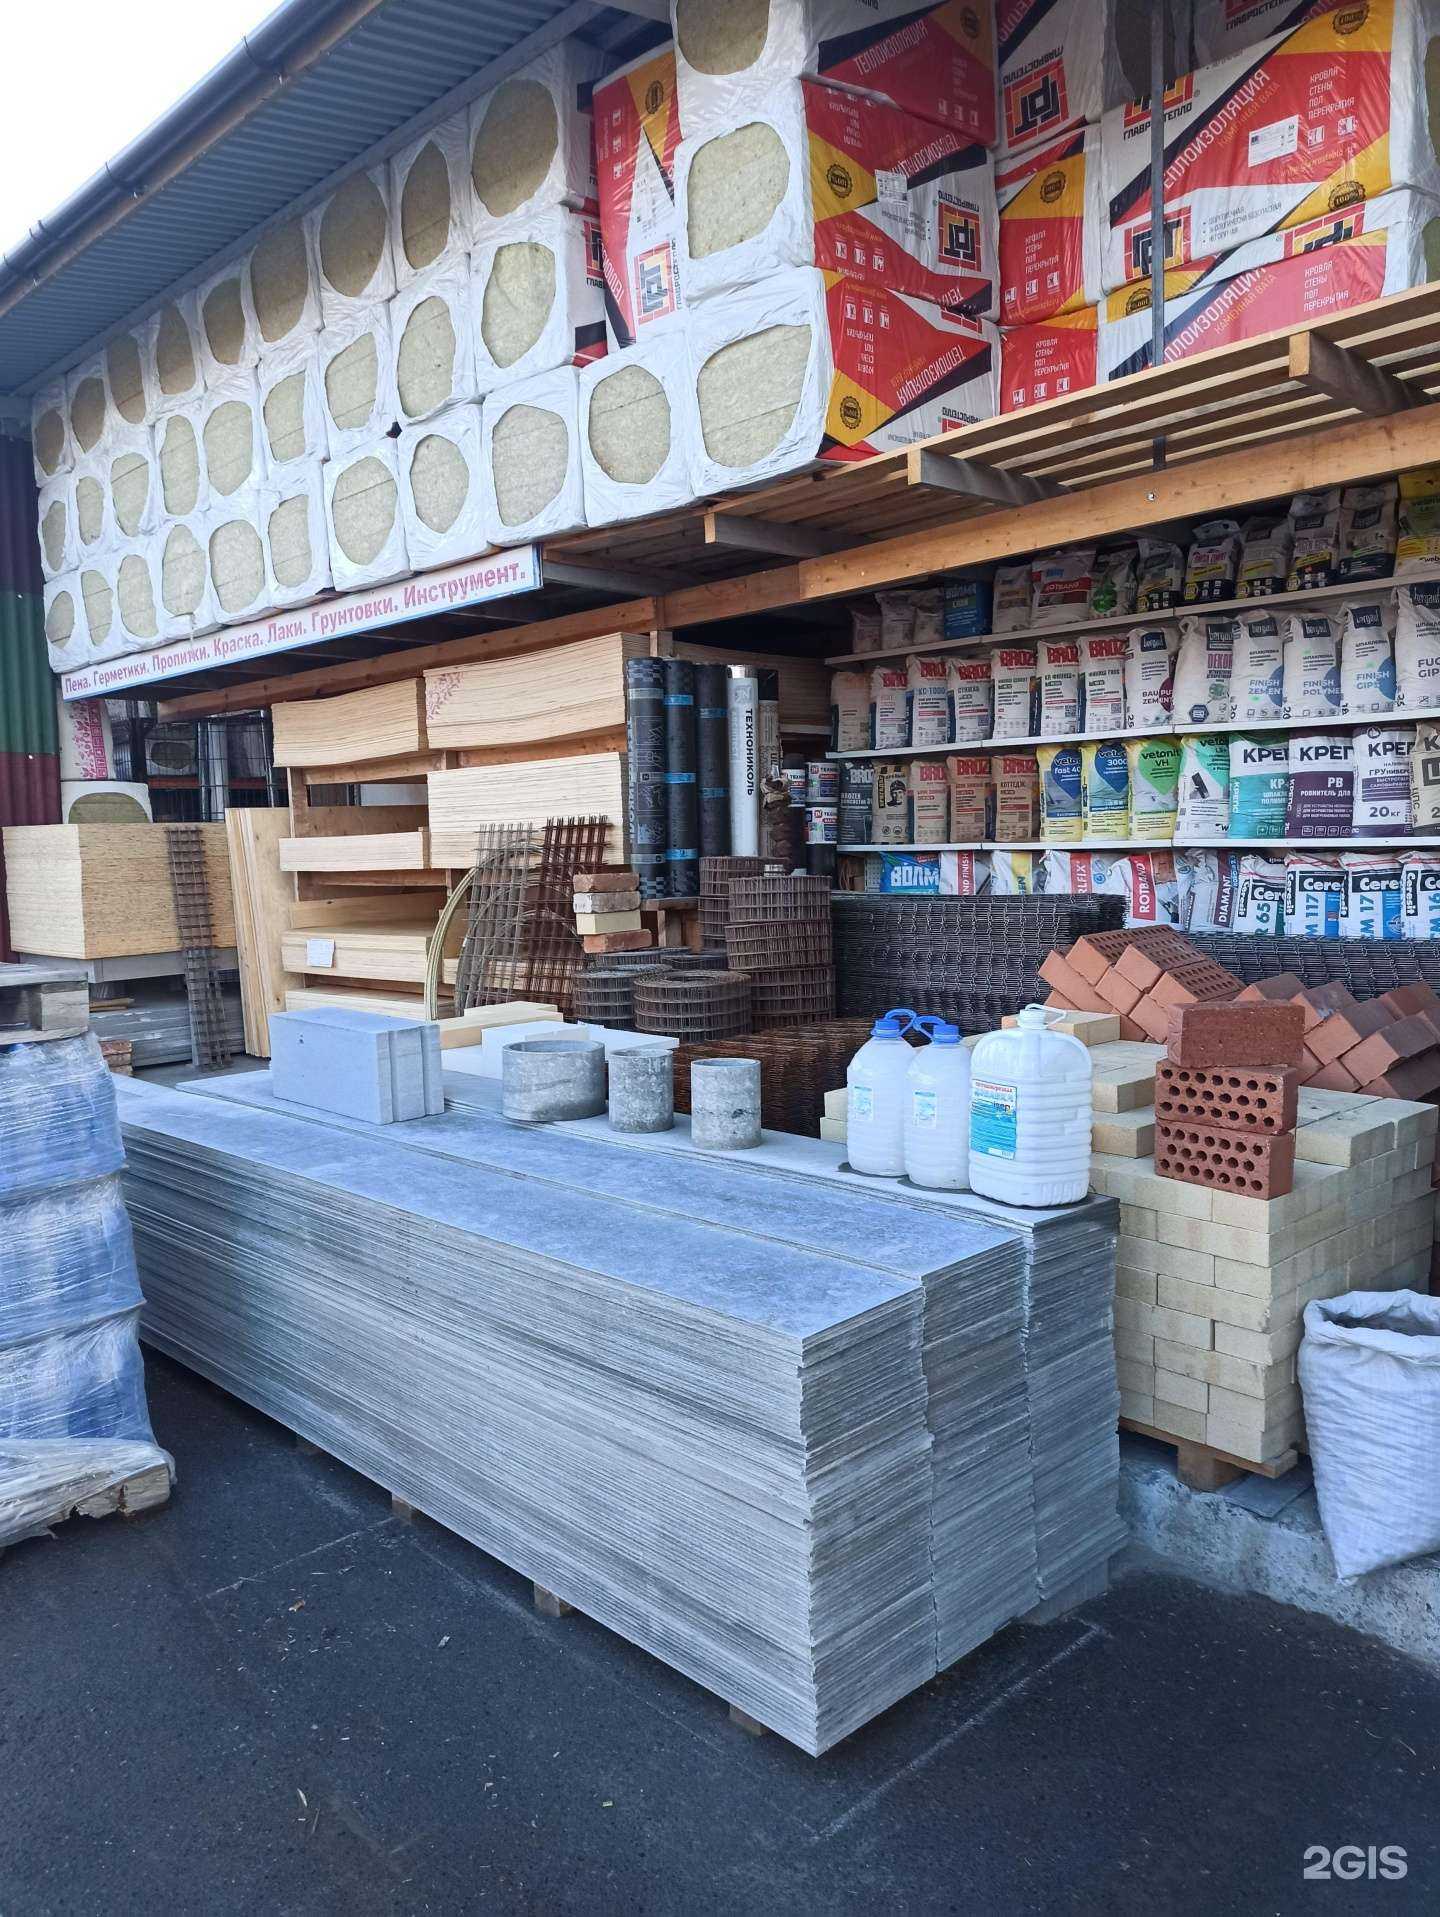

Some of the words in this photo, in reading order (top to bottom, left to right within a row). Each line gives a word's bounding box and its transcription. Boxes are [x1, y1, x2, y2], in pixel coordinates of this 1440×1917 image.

[1310, 65, 1340, 83] КРОВЛЯ
[1309, 81, 1333, 96] СТЕНЫ
[1309, 95, 1324, 108] ПОЛ
[1163, 69, 1271, 190] ЕПЛОИЗОЛЯЦИЯ
[1304, 261, 1333, 275] КРОВЛЯ
[1304, 275, 1328, 289] СТЕНЫ
[1303, 290, 1350, 312] ПЕРЕКРЫТИЯ
[1304, 289, 1318, 301] ПОЛ
[1164, 267, 1267, 362] ПЛОИЗОЛЯЦИ
[895, 344, 967, 406] ТЕПЛОИЗОЛЯЦИЯ
[65, 676, 92, 694] Пена.
[93, 661, 150, 688] Герметики.
[152, 645, 211, 672] Пропитки.
[213, 630, 264, 656] Краска.
[267, 618, 308, 644] Лаки.
[311, 597, 399, 635] Грунтовки.
[402, 562, 526, 609] Инструмент.
[1356, 671, 1390, 681] FINISH
[1418, 669, 1440, 678] GIP
[1249, 679, 1280, 687] FINISH
[1303, 680, 1335, 688] FINISH
[1142, 690, 1158, 698] BAU
[745, 707, 755, 797] ТЕХНОНИКОЛЬ
[1141, 749, 1181, 760] vetonit
[1299, 745, 1354, 761] КРЕП
[1368, 741, 1416, 757] КРЕП
[1054, 766, 1071, 775] fast
[1327, 776, 1344, 788] РВ
[1369, 806, 1390, 817] 20
[962, 853, 970, 879] FINISH
[1137, 862, 1151, 914] ROTBAND
[1359, 876, 1400, 891] Cere
[1218, 874, 1232, 923] DIAMANT
[1286, 871, 1295, 915] Ceresit
[1406, 870, 1417, 916] Ceresit
[1305, 893, 1319, 917] 117
[1359, 894, 1374, 913] 17
[1257, 902, 1272, 924] 65
